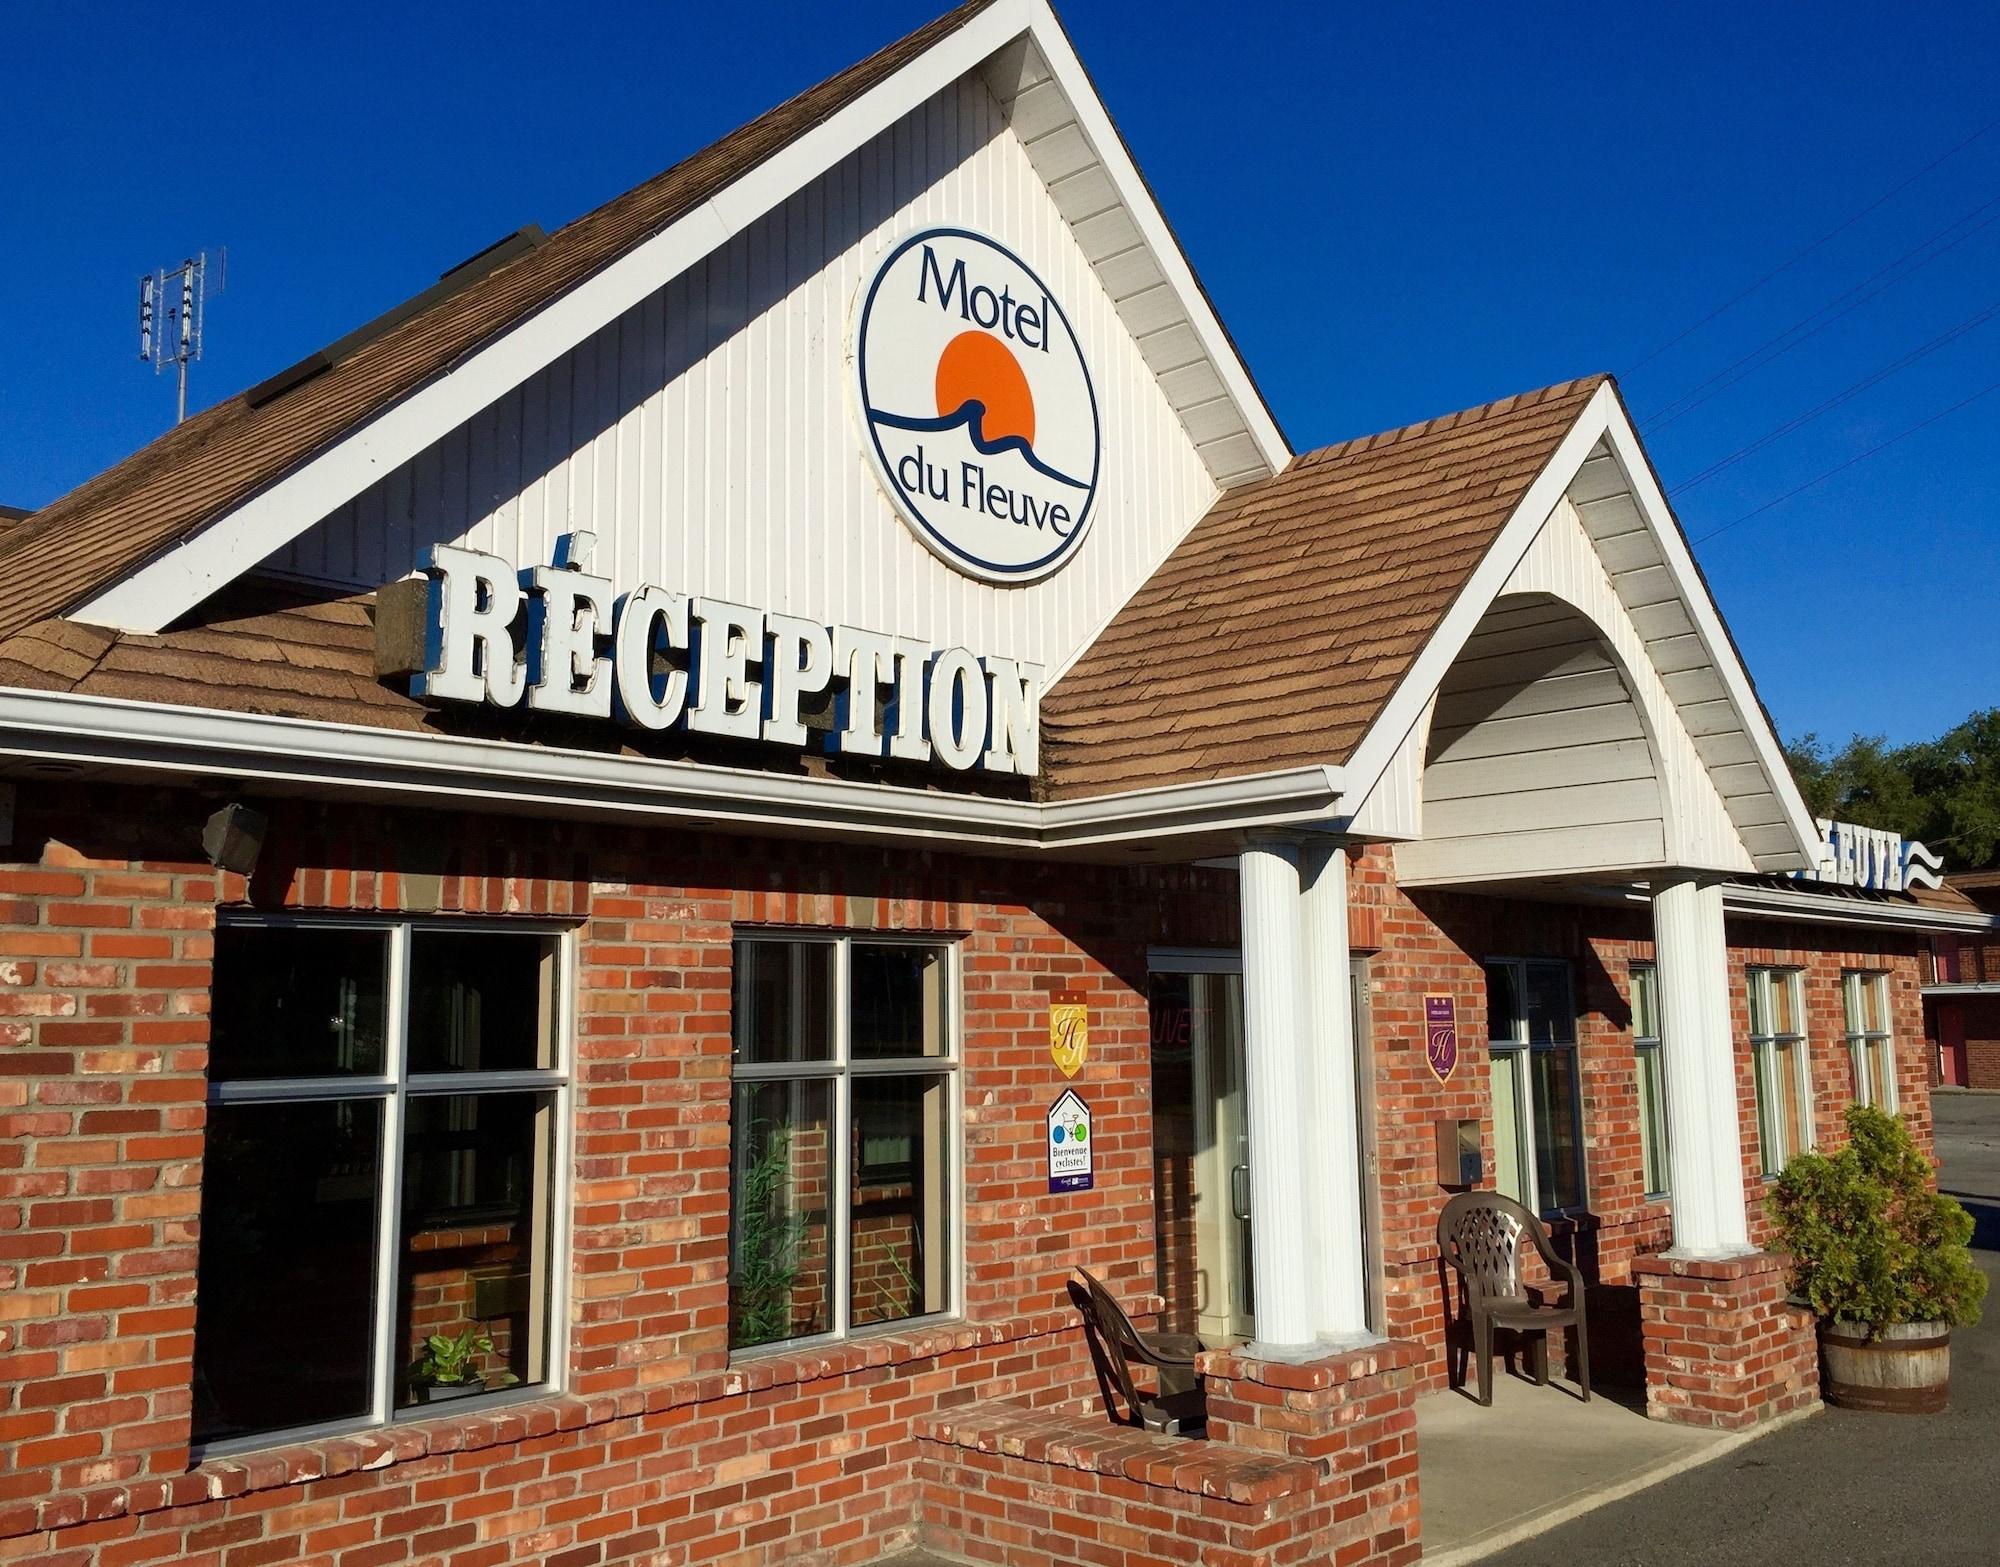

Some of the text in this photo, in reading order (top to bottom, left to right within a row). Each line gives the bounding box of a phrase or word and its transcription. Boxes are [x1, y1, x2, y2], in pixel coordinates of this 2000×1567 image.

[917, 244, 1050, 353] Motel
[899, 445, 1070, 538] du Fleuve
[422, 530, 1046, 777] RÉCEPTION
[1052, 1146, 1088, 1158] Bienvenue
[1055, 1155, 1086, 1168] cyclistes!
